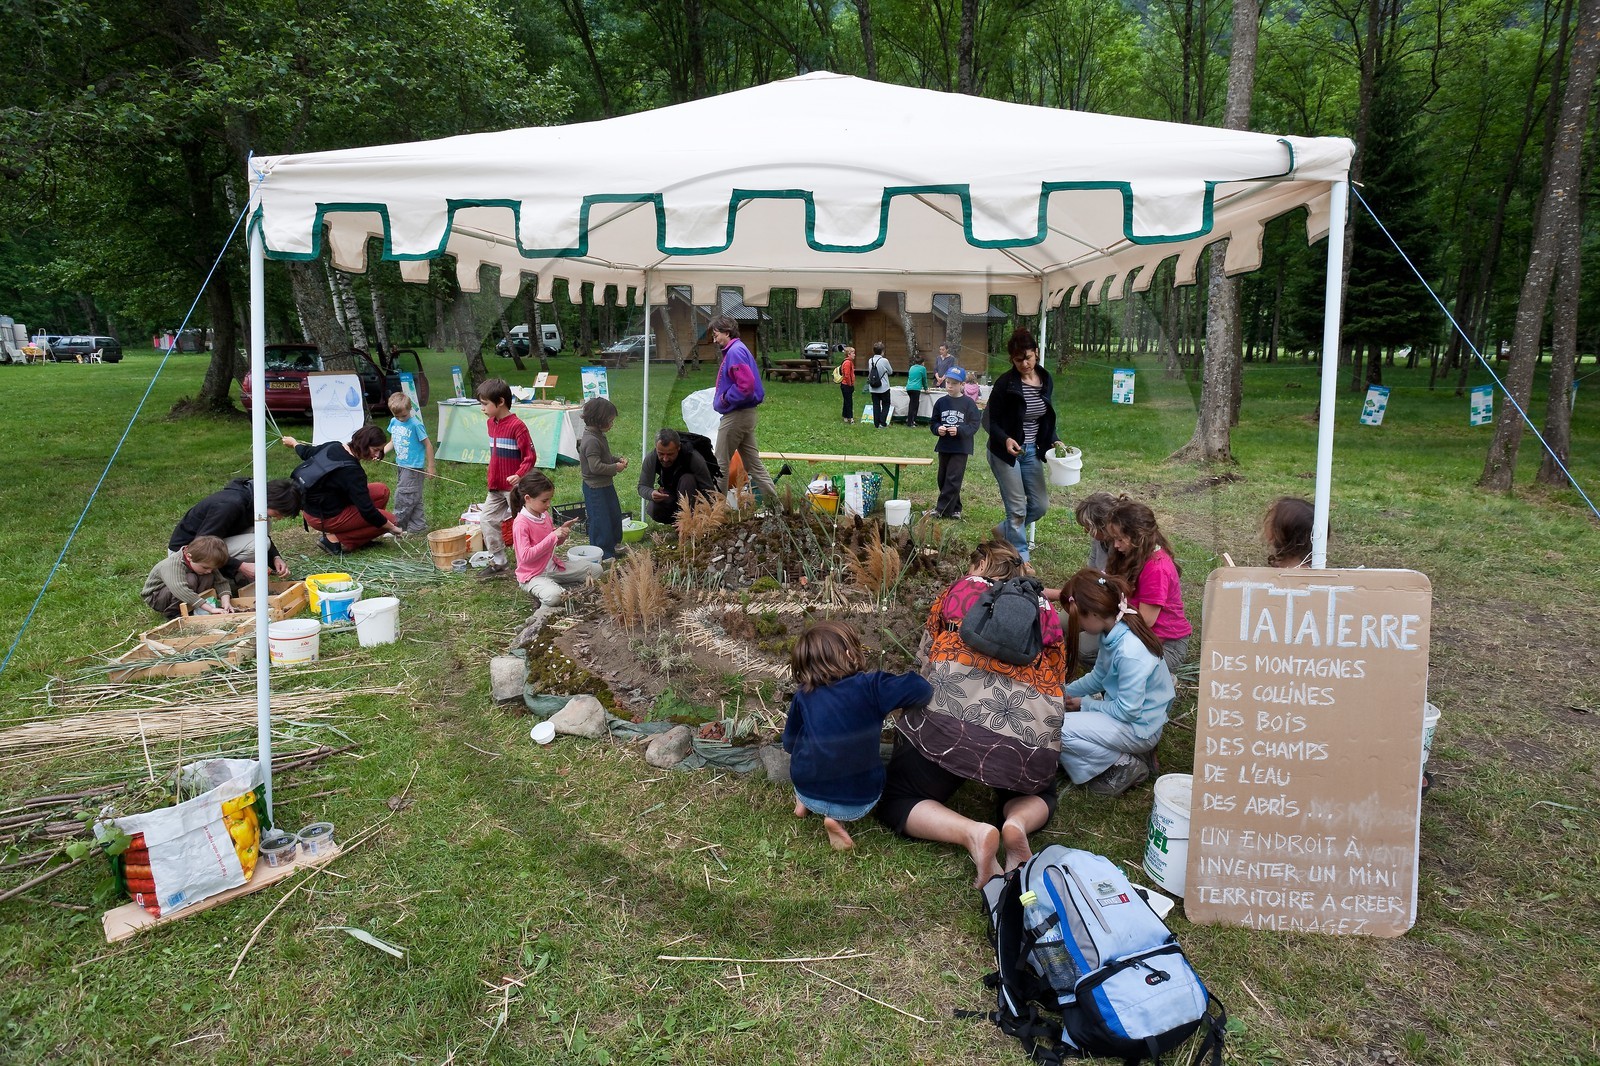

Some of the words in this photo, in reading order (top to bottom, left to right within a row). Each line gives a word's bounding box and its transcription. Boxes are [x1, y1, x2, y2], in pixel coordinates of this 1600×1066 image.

[1211, 650, 1248, 672] DES
[1255, 654, 1367, 679] MONTAGNES
[1210, 680, 1243, 700] DES
[1208, 706, 1245, 728] DES
[1206, 736, 1245, 756] DES
[1251, 740, 1330, 761] CHAMPS
[1204, 763, 1228, 783] DE
[1238, 762, 1291, 786] L'EAU
[1203, 792, 1237, 812] DES
[1201, 827, 1231, 846] UN
[1343, 834, 1361, 859] À
[1199, 855, 1301, 883] INVENTER
[1309, 865, 1336, 882] UN
[1340, 894, 1406, 914] CREER
